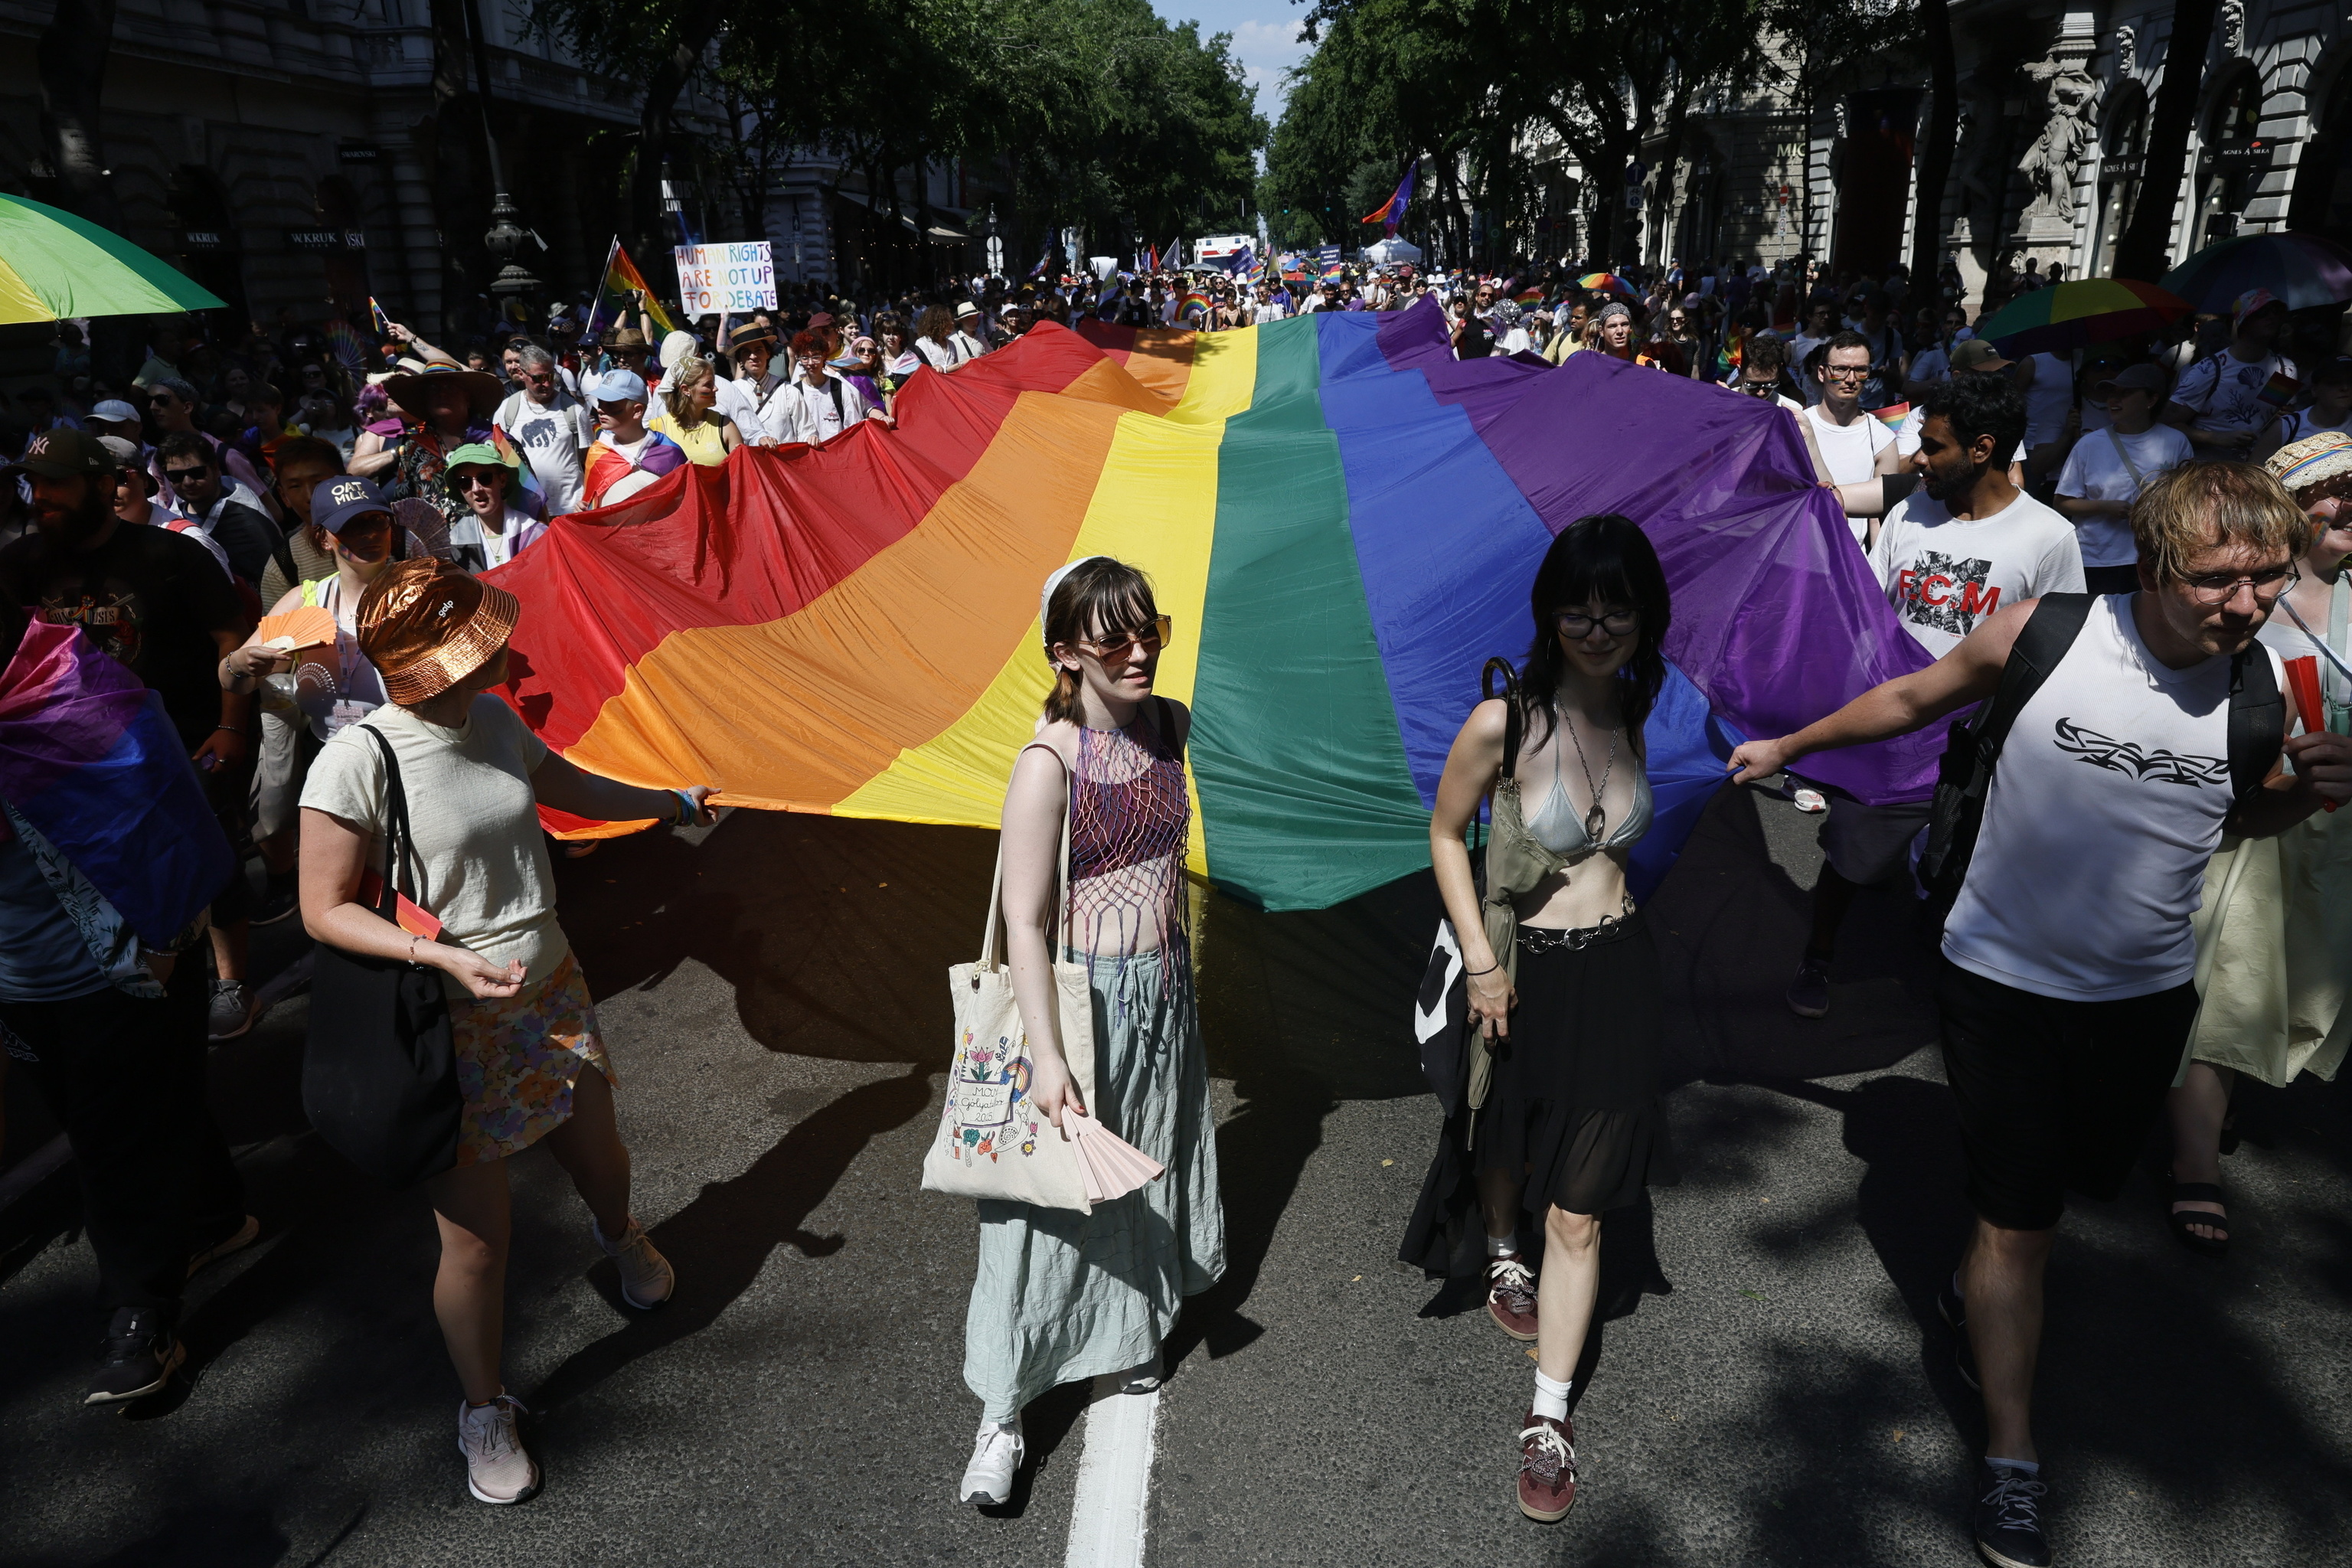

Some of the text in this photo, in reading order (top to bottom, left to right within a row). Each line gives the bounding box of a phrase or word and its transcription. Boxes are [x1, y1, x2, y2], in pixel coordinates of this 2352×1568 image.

[2203, 155, 2213, 164] AG
[2104, 165, 2119, 173] AGNES
[665, 200, 683, 212] LIVE
[676, 247, 726, 266] HUMAN
[728, 244, 773, 263] RIGHTS
[682, 266, 772, 289] ARE NOT UP
[683, 290, 776, 311] FOR DEBATE
[28, 436, 50, 455] NY
[331, 482, 363, 496] OAT
[334, 491, 369, 506] MILK
[92, 610, 115, 623] OSES
[438, 600, 453, 618] galp
